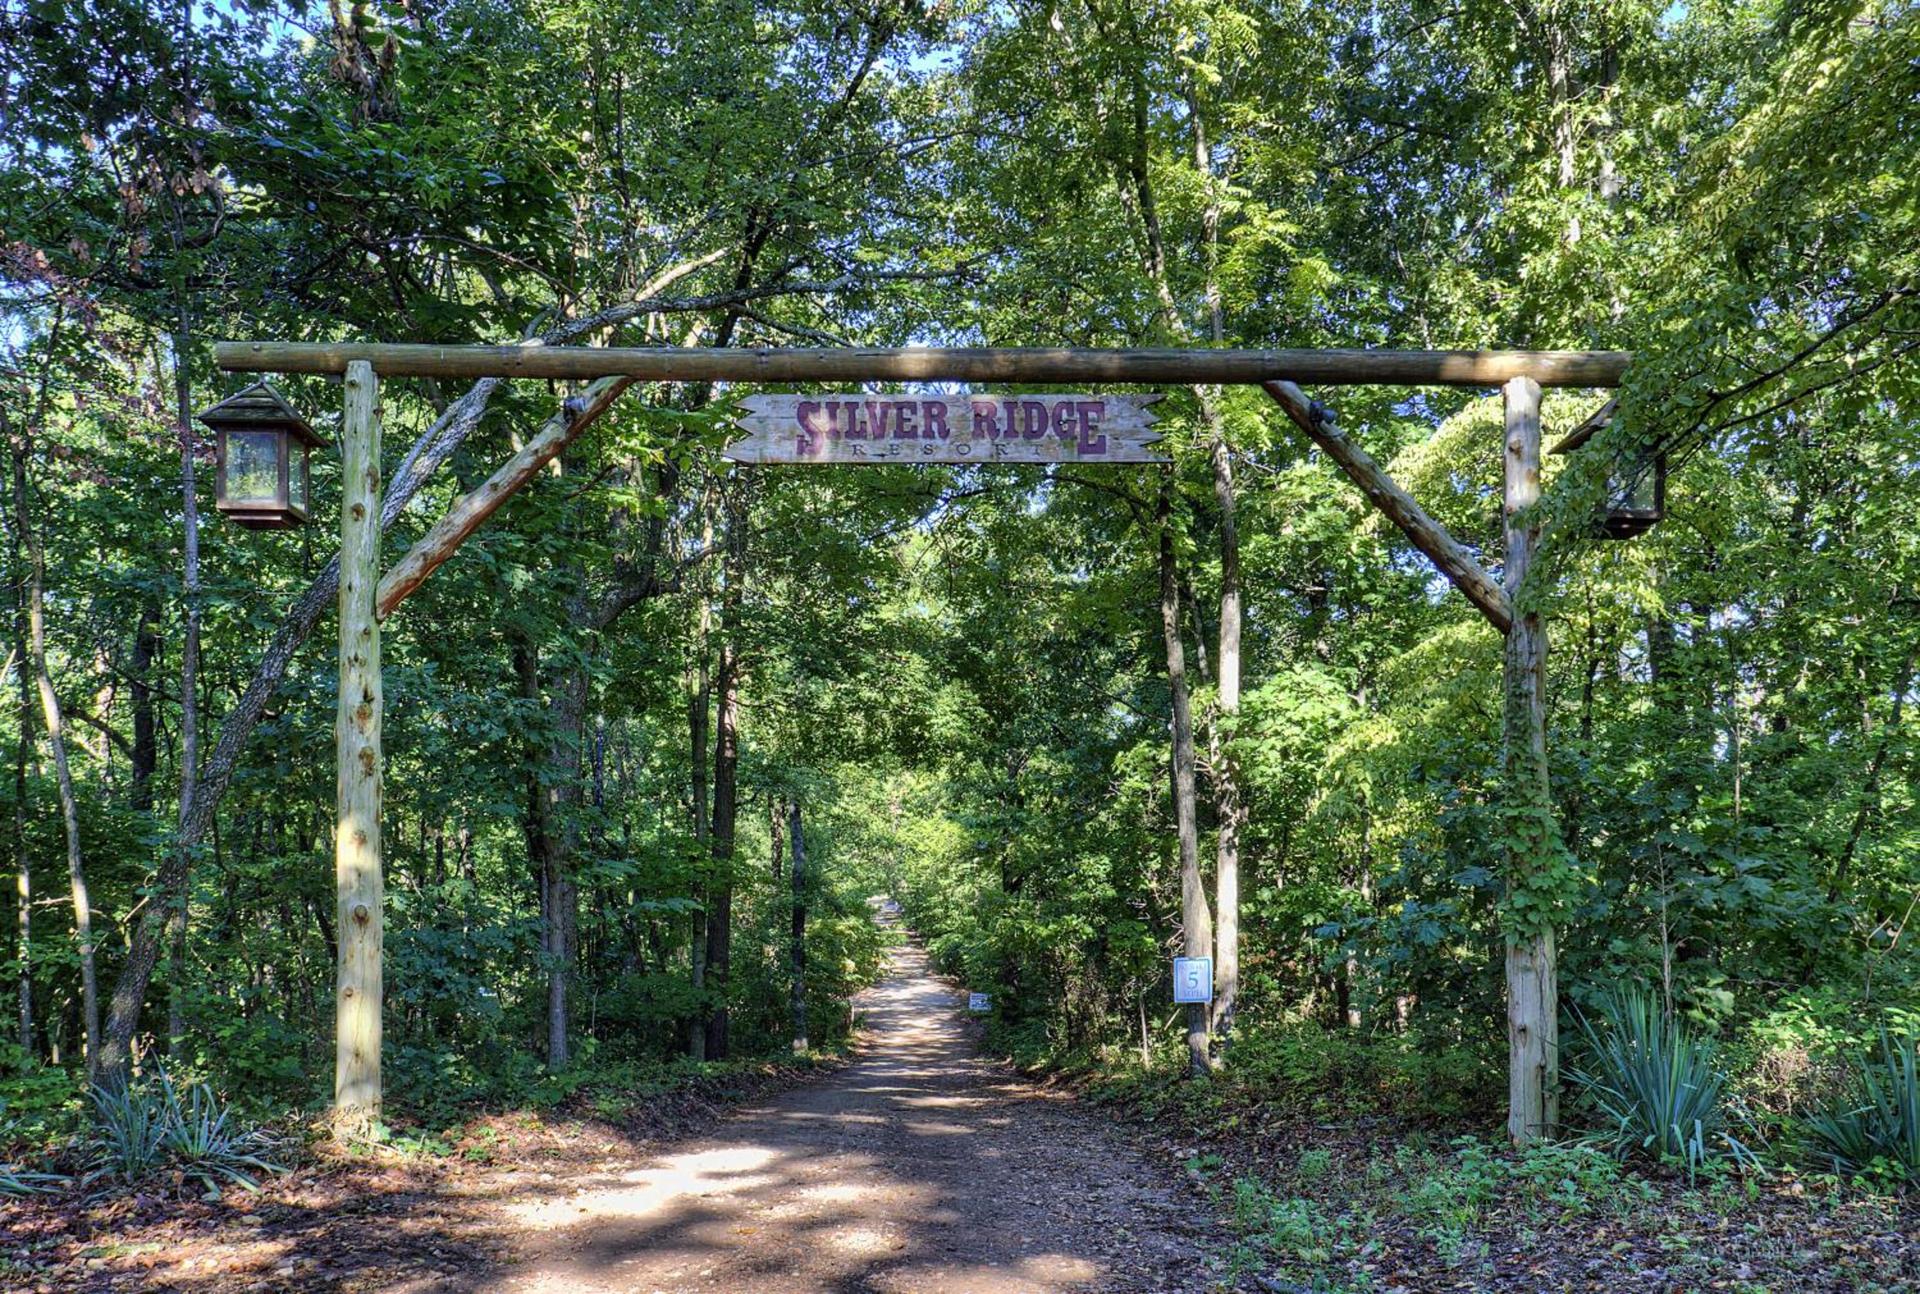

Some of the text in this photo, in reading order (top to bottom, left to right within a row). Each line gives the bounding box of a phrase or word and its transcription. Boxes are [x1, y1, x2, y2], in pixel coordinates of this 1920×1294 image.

[796, 401, 1107, 455] SILVER RIDGE
[851, 443, 1043, 456] RESORT
[1187, 971, 1198, 989] 5
